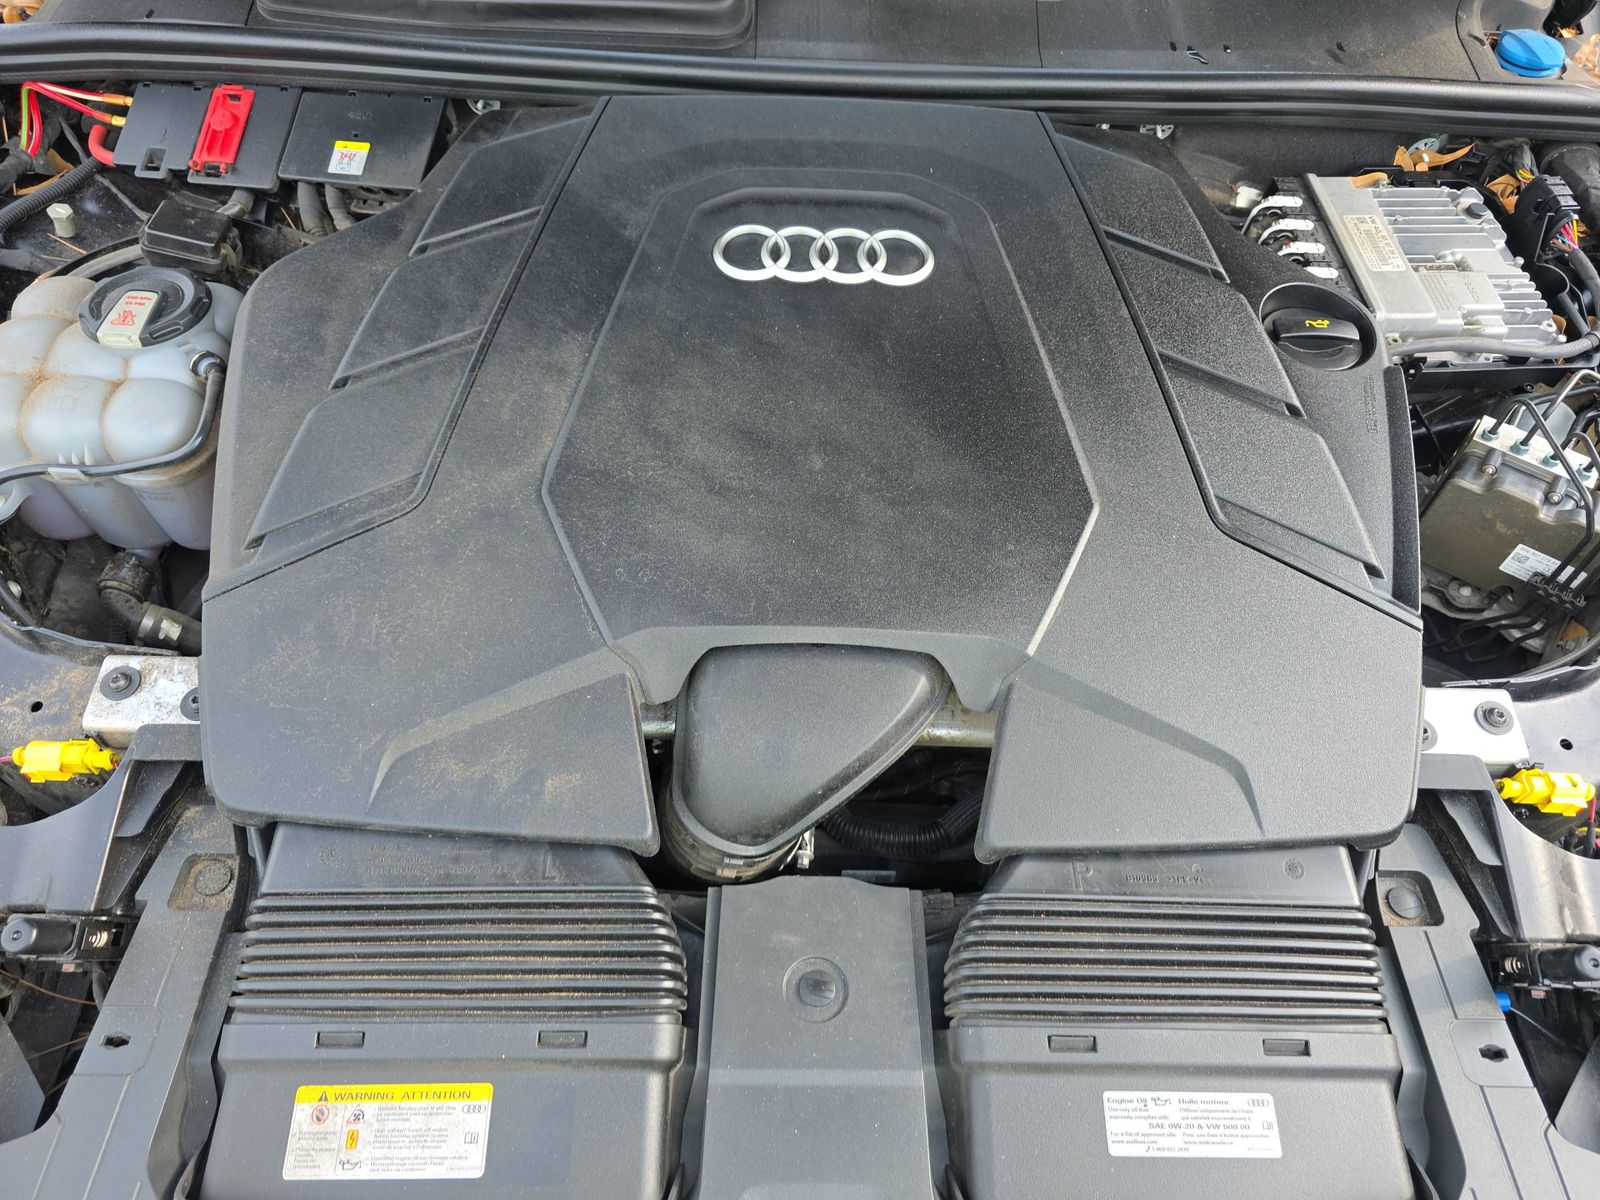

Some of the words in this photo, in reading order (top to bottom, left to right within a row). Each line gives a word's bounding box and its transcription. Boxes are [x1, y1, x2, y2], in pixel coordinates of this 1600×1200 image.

[334, 1090, 395, 1101] WARNING
[401, 1090, 472, 1100] ATTENTION
[1107, 1097, 1134, 1105] Engine
